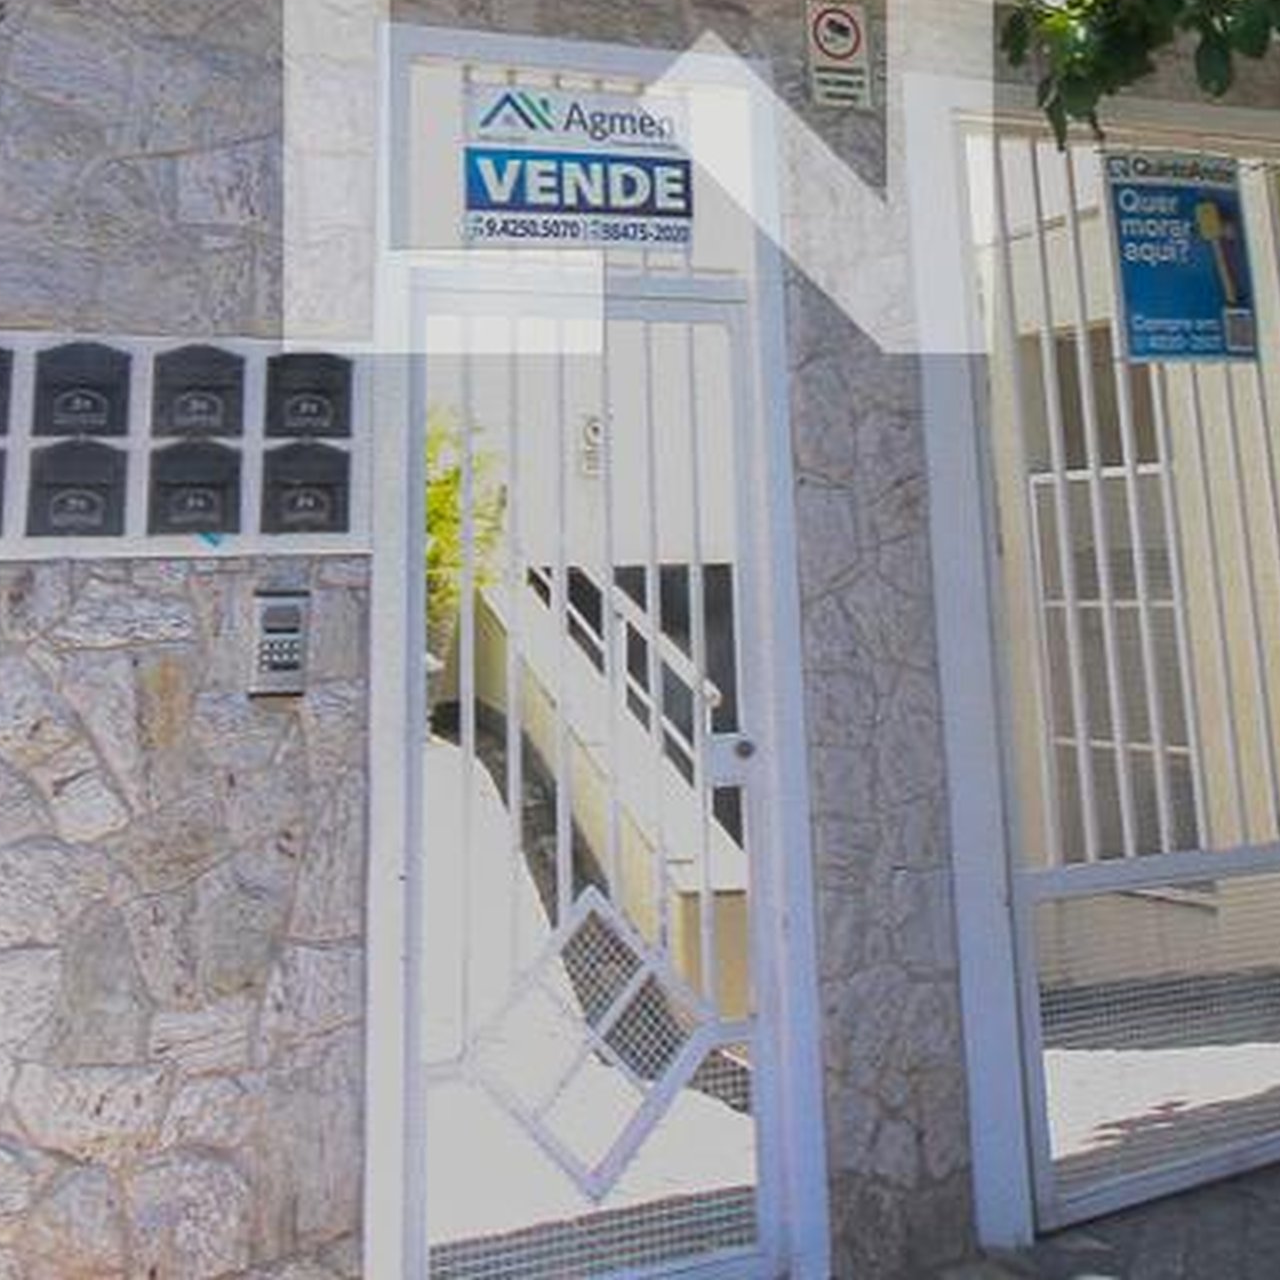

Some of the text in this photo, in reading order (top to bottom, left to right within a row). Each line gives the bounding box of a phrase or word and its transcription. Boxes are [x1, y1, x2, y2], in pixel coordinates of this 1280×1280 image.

[476, 157, 687, 209] VENDE
[1122, 219, 1193, 238] morar
[1124, 241, 1191, 267] aqui?
